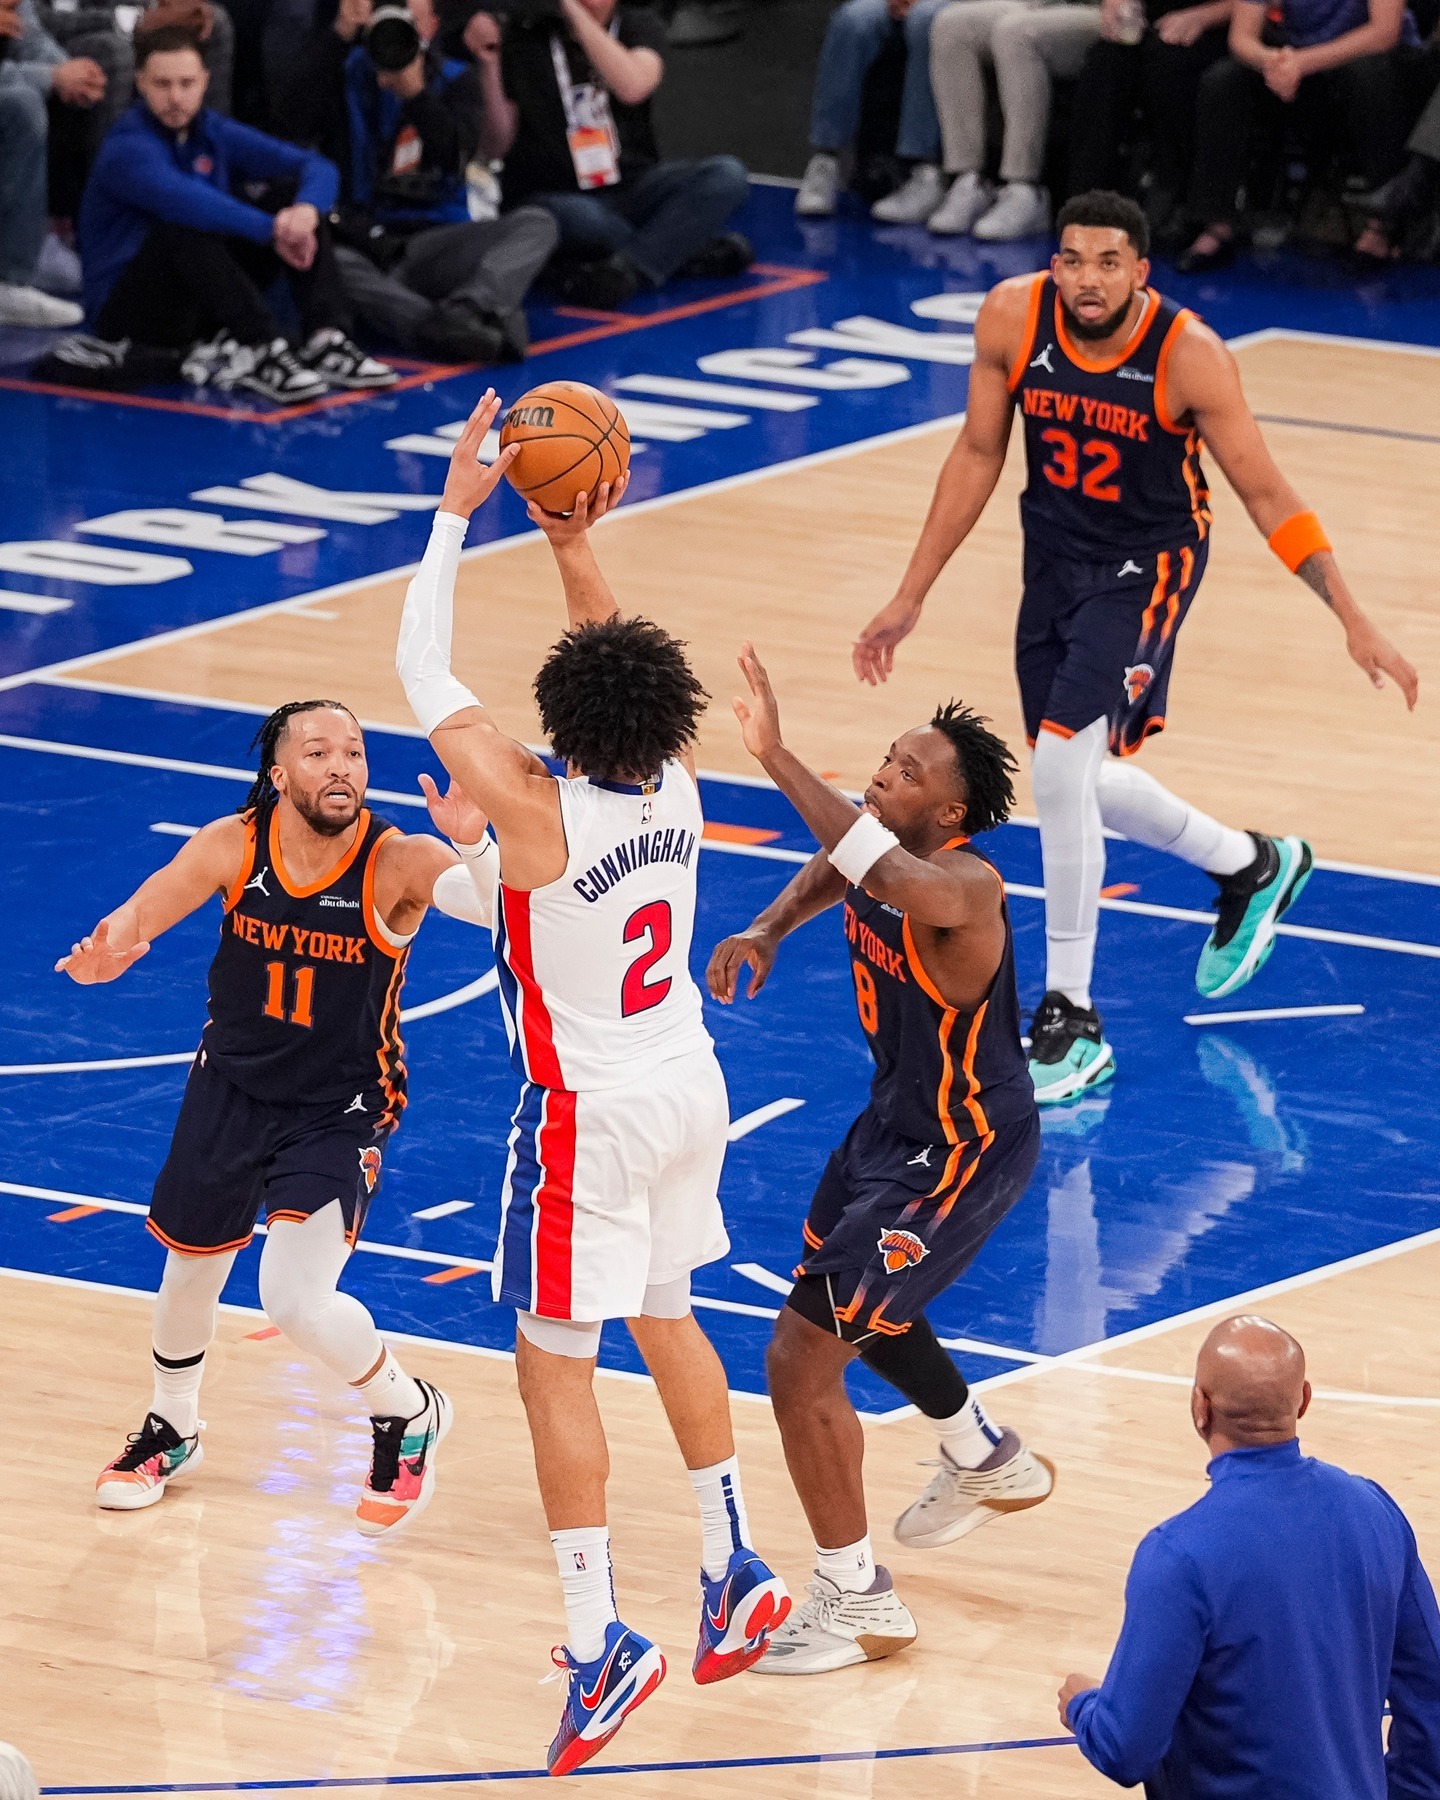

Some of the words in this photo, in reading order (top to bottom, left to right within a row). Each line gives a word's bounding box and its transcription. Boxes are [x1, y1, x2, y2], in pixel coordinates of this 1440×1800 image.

[1023, 388, 1078, 422] NEW
[1080, 397, 1150, 443] YORK
[1041, 428, 1122, 503] 32
[0, 472, 446, 616] ORK
[232, 910, 289, 951] NEW
[291, 925, 366, 964] YORK
[621, 899, 672, 1019] 2
[858, 921, 906, 983] YORK
[263, 961, 316, 1029] 11
[852, 959, 878, 1036] 8
